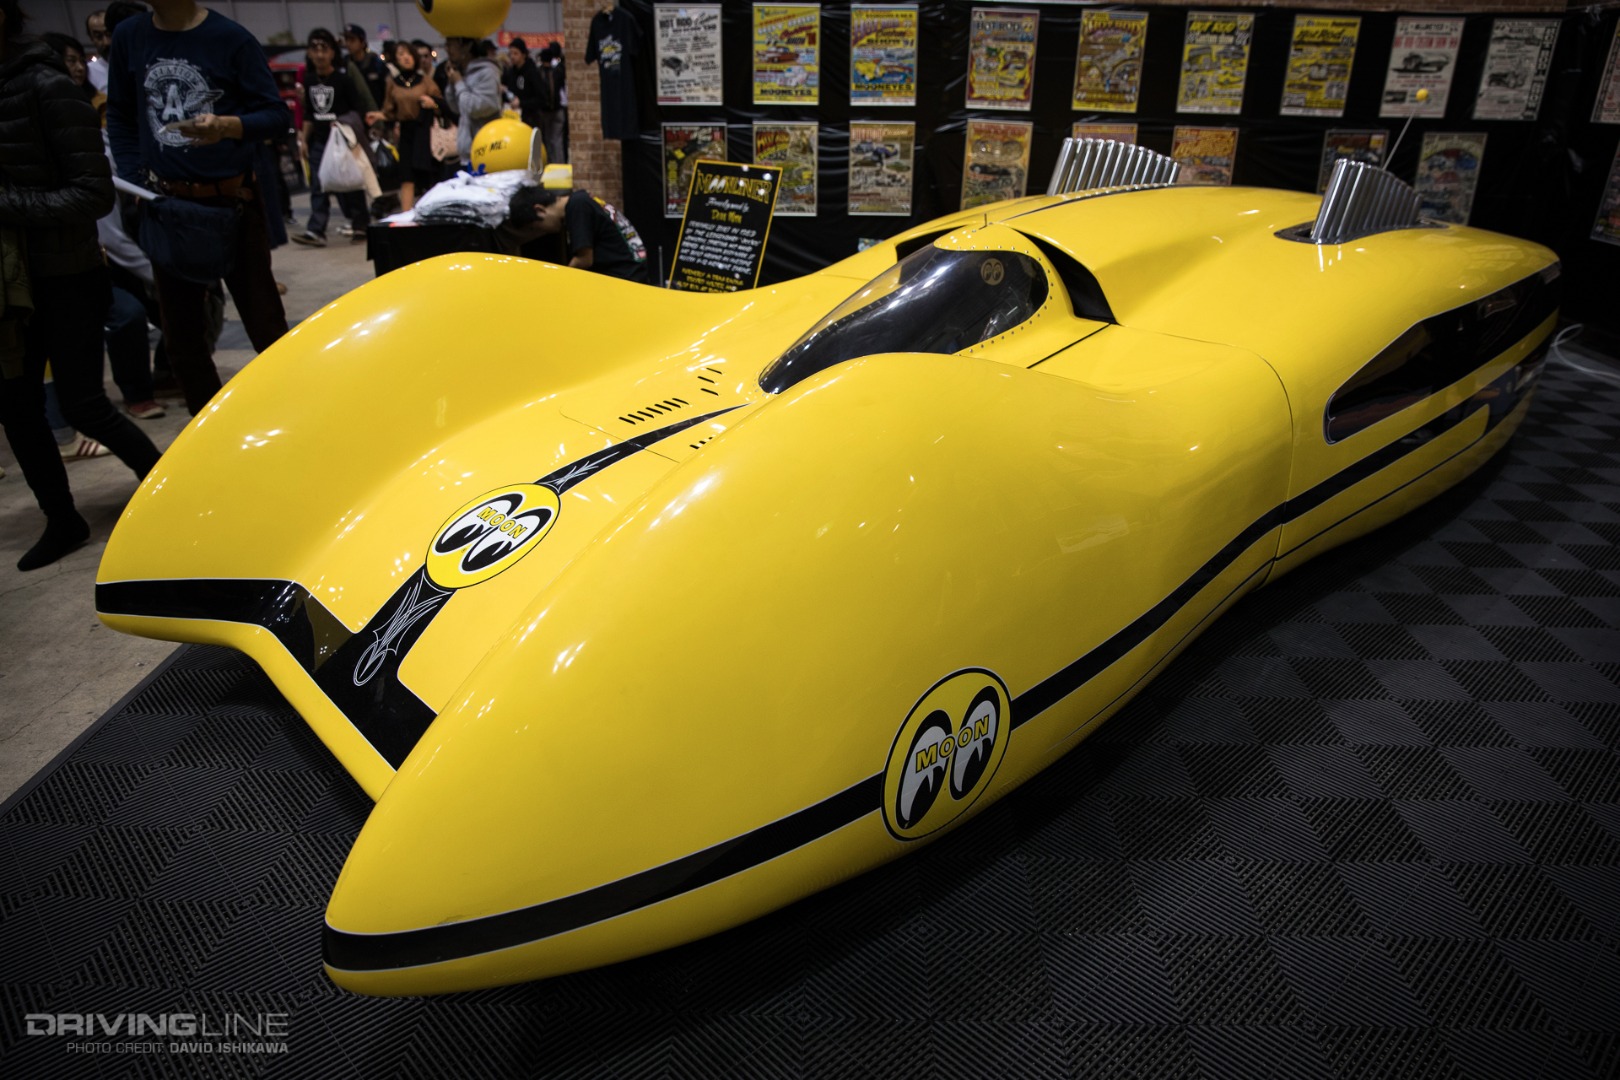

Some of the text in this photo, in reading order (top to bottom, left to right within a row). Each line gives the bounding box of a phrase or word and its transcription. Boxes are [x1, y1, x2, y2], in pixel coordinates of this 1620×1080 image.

[161, 83, 186, 121] A
[693, 169, 773, 204] MOONLINER
[477, 506, 528, 539] MOON
[915, 714, 990, 773] MOON
